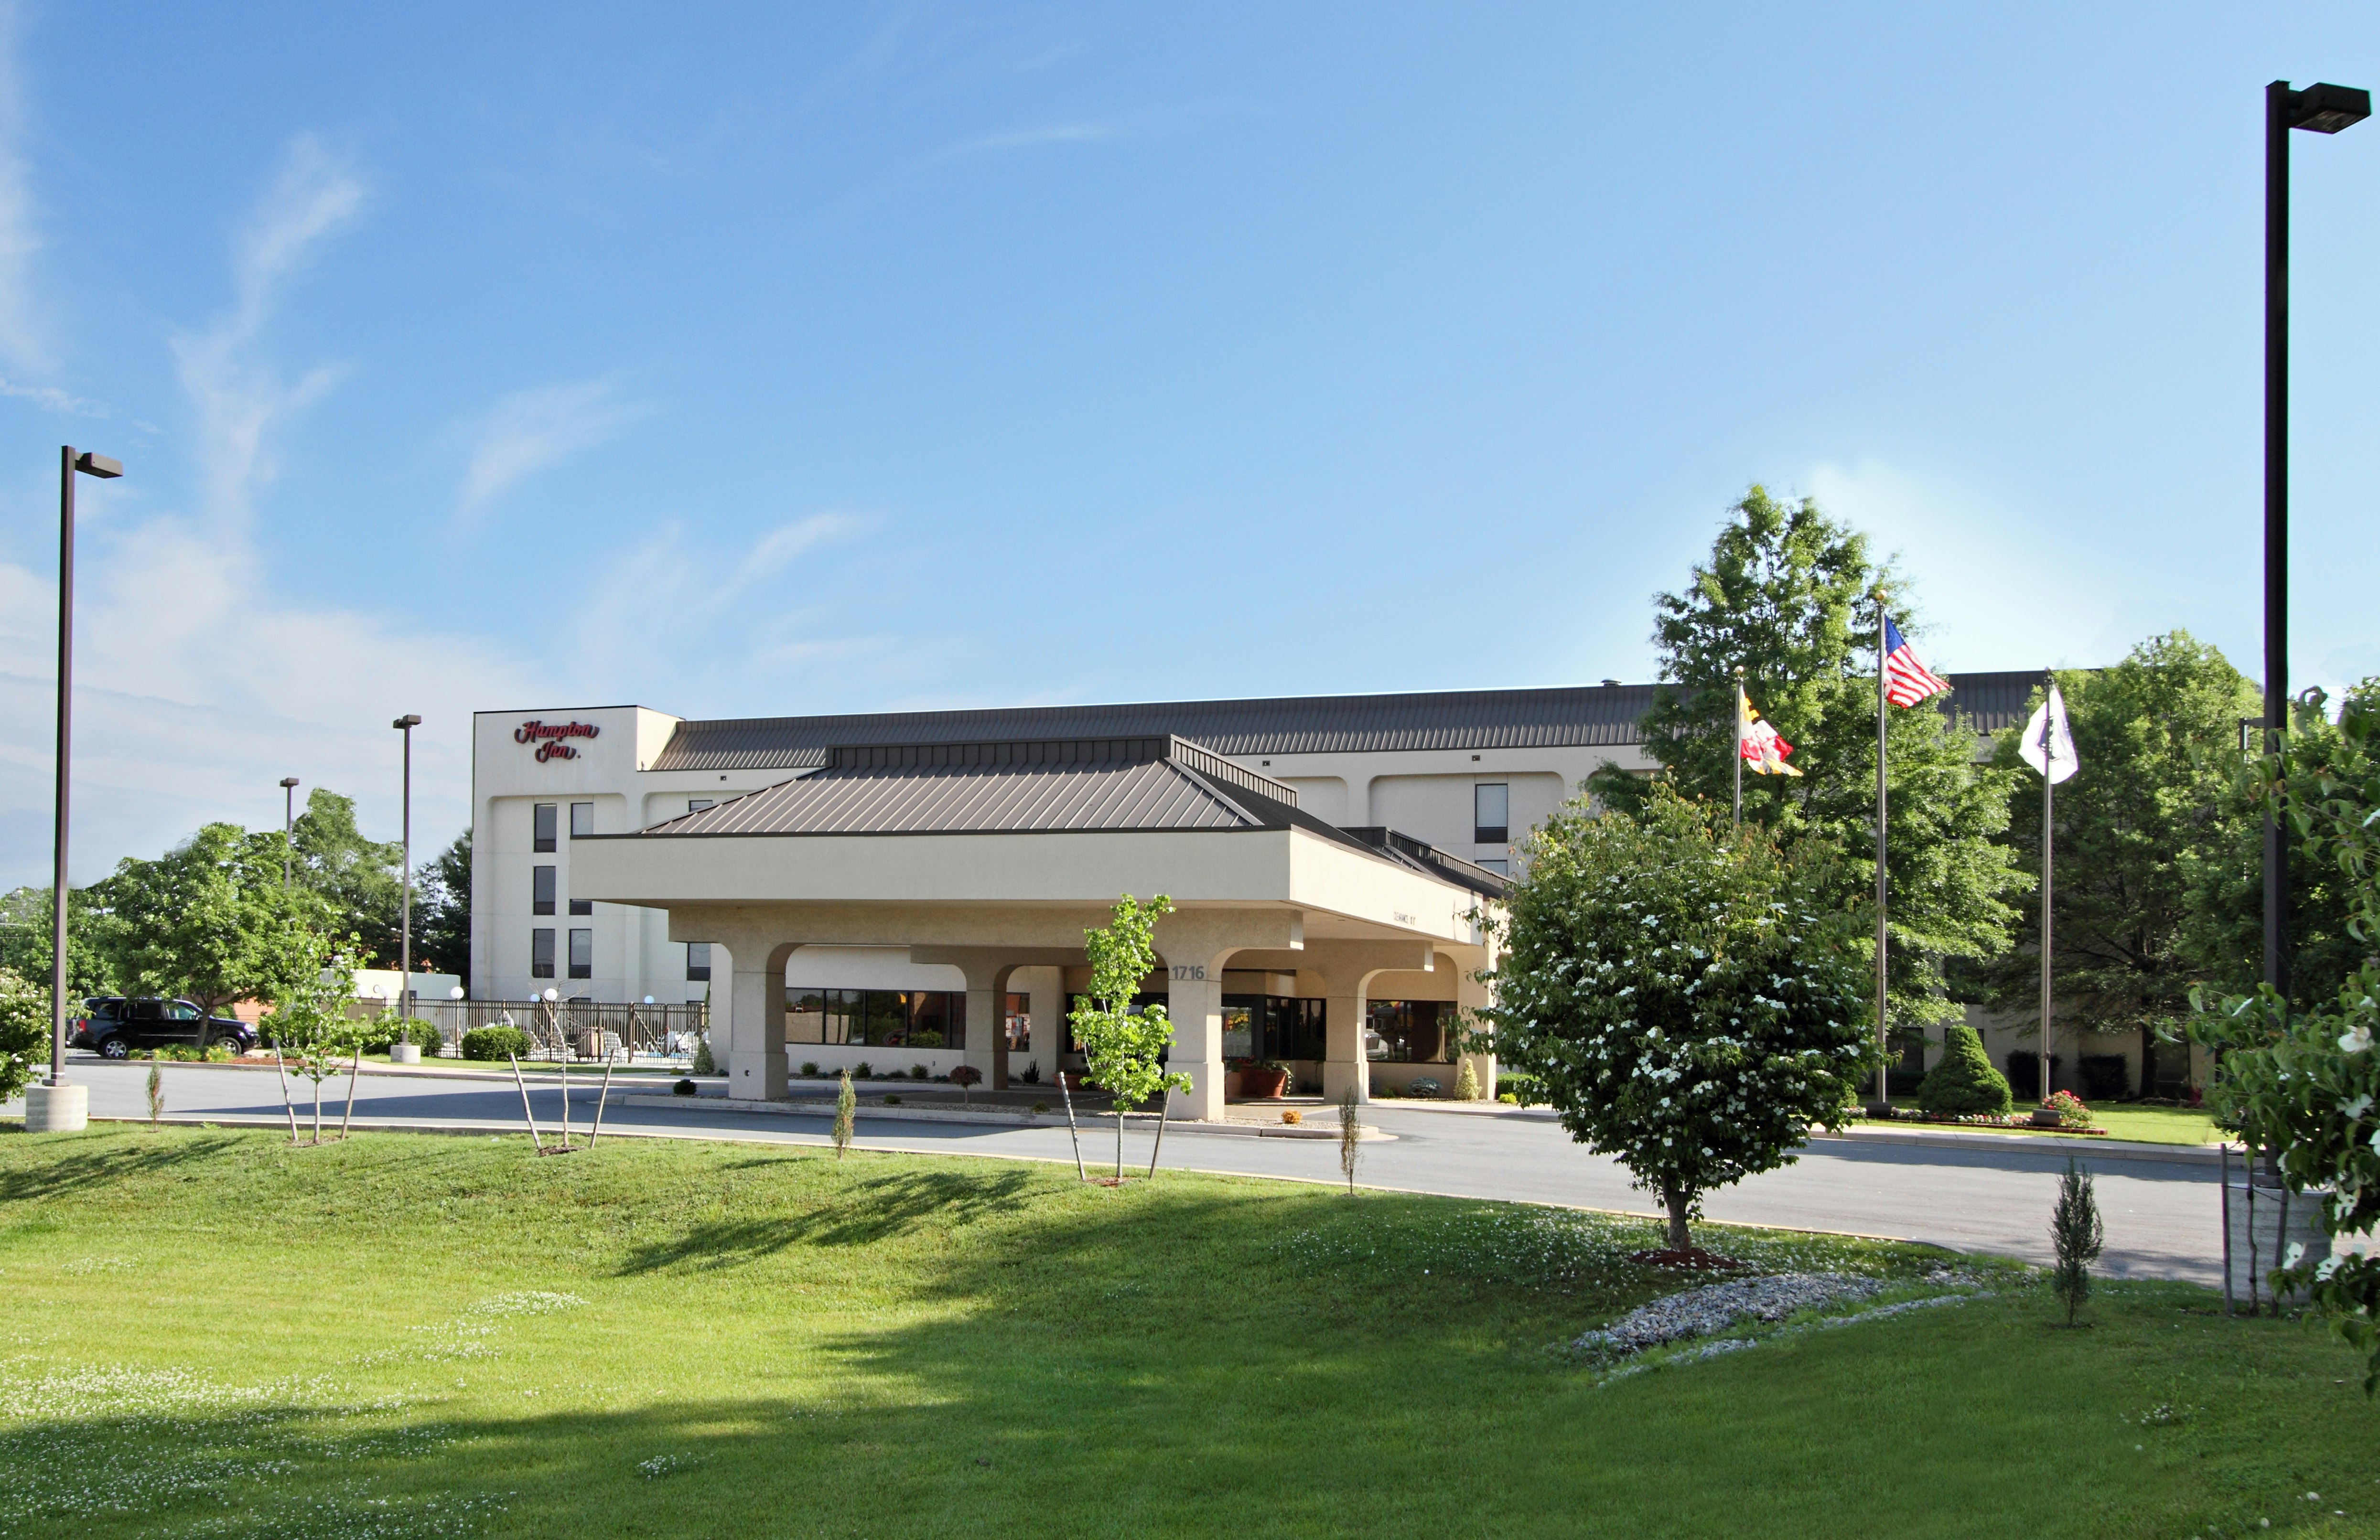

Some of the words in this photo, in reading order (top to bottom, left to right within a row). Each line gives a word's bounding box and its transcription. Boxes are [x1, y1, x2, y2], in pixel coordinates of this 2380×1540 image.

[514, 720, 600, 744] Hampton
[535, 741, 577, 763] Inn
[1172, 966, 1204, 979] 1716
